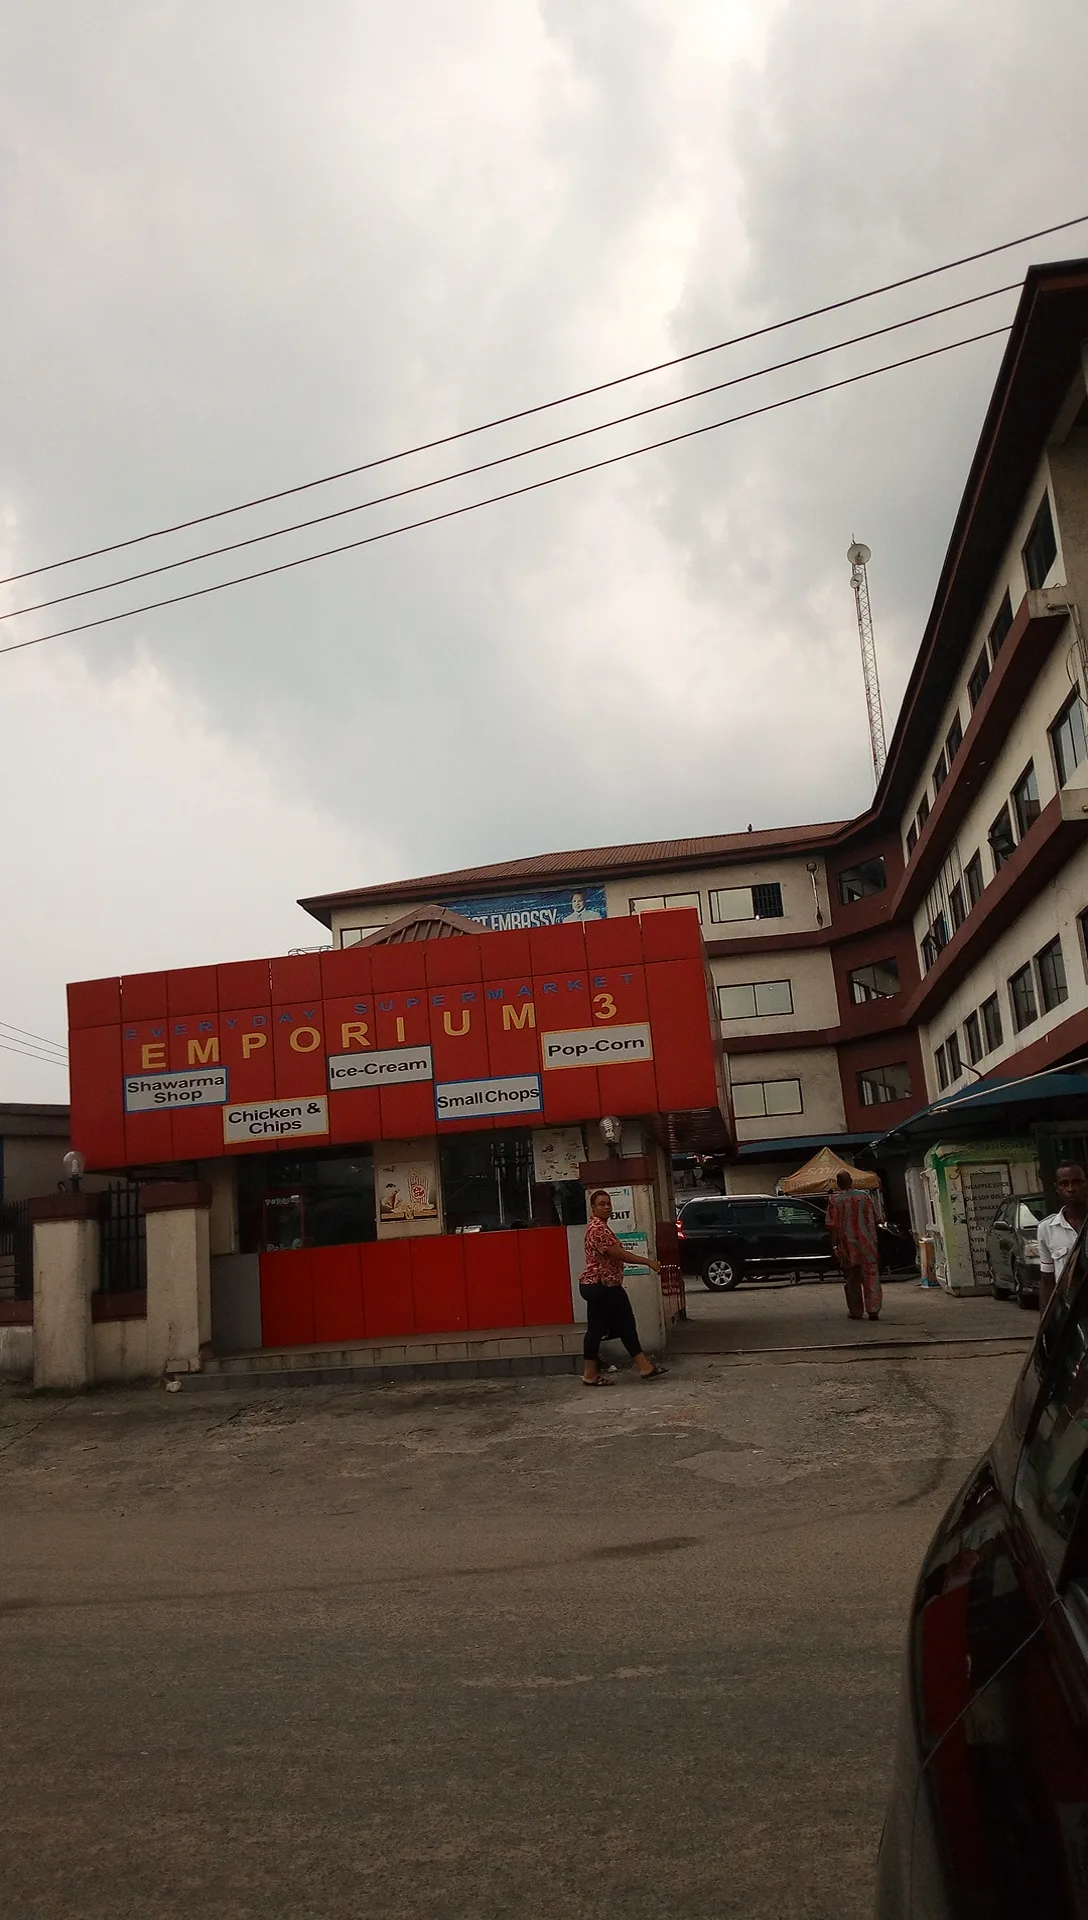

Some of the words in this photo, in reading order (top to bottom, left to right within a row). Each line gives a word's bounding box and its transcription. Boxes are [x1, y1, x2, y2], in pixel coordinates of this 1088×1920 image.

[491, 908, 558, 932] EMBASSY
[125, 1008, 318, 1040] EVERYDAY
[354, 972, 633, 1015] SUPERMARKET
[141, 1002, 536, 1070] EMPORIUM
[593, 992, 617, 1019] 3
[548, 1038, 645, 1058] Pop-Corn
[330, 1058, 428, 1079] Ice-Cream
[127, 1075, 225, 1093] Shawarma
[153, 1089, 203, 1104] Shop
[437, 1091, 484, 1109] Small
[484, 1087, 540, 1106] Chops
[228, 1105, 302, 1124] Chicken
[306, 1102, 321, 1114] &
[248, 1119, 302, 1134] Chips
[610, 1210, 631, 1220] EXIT
